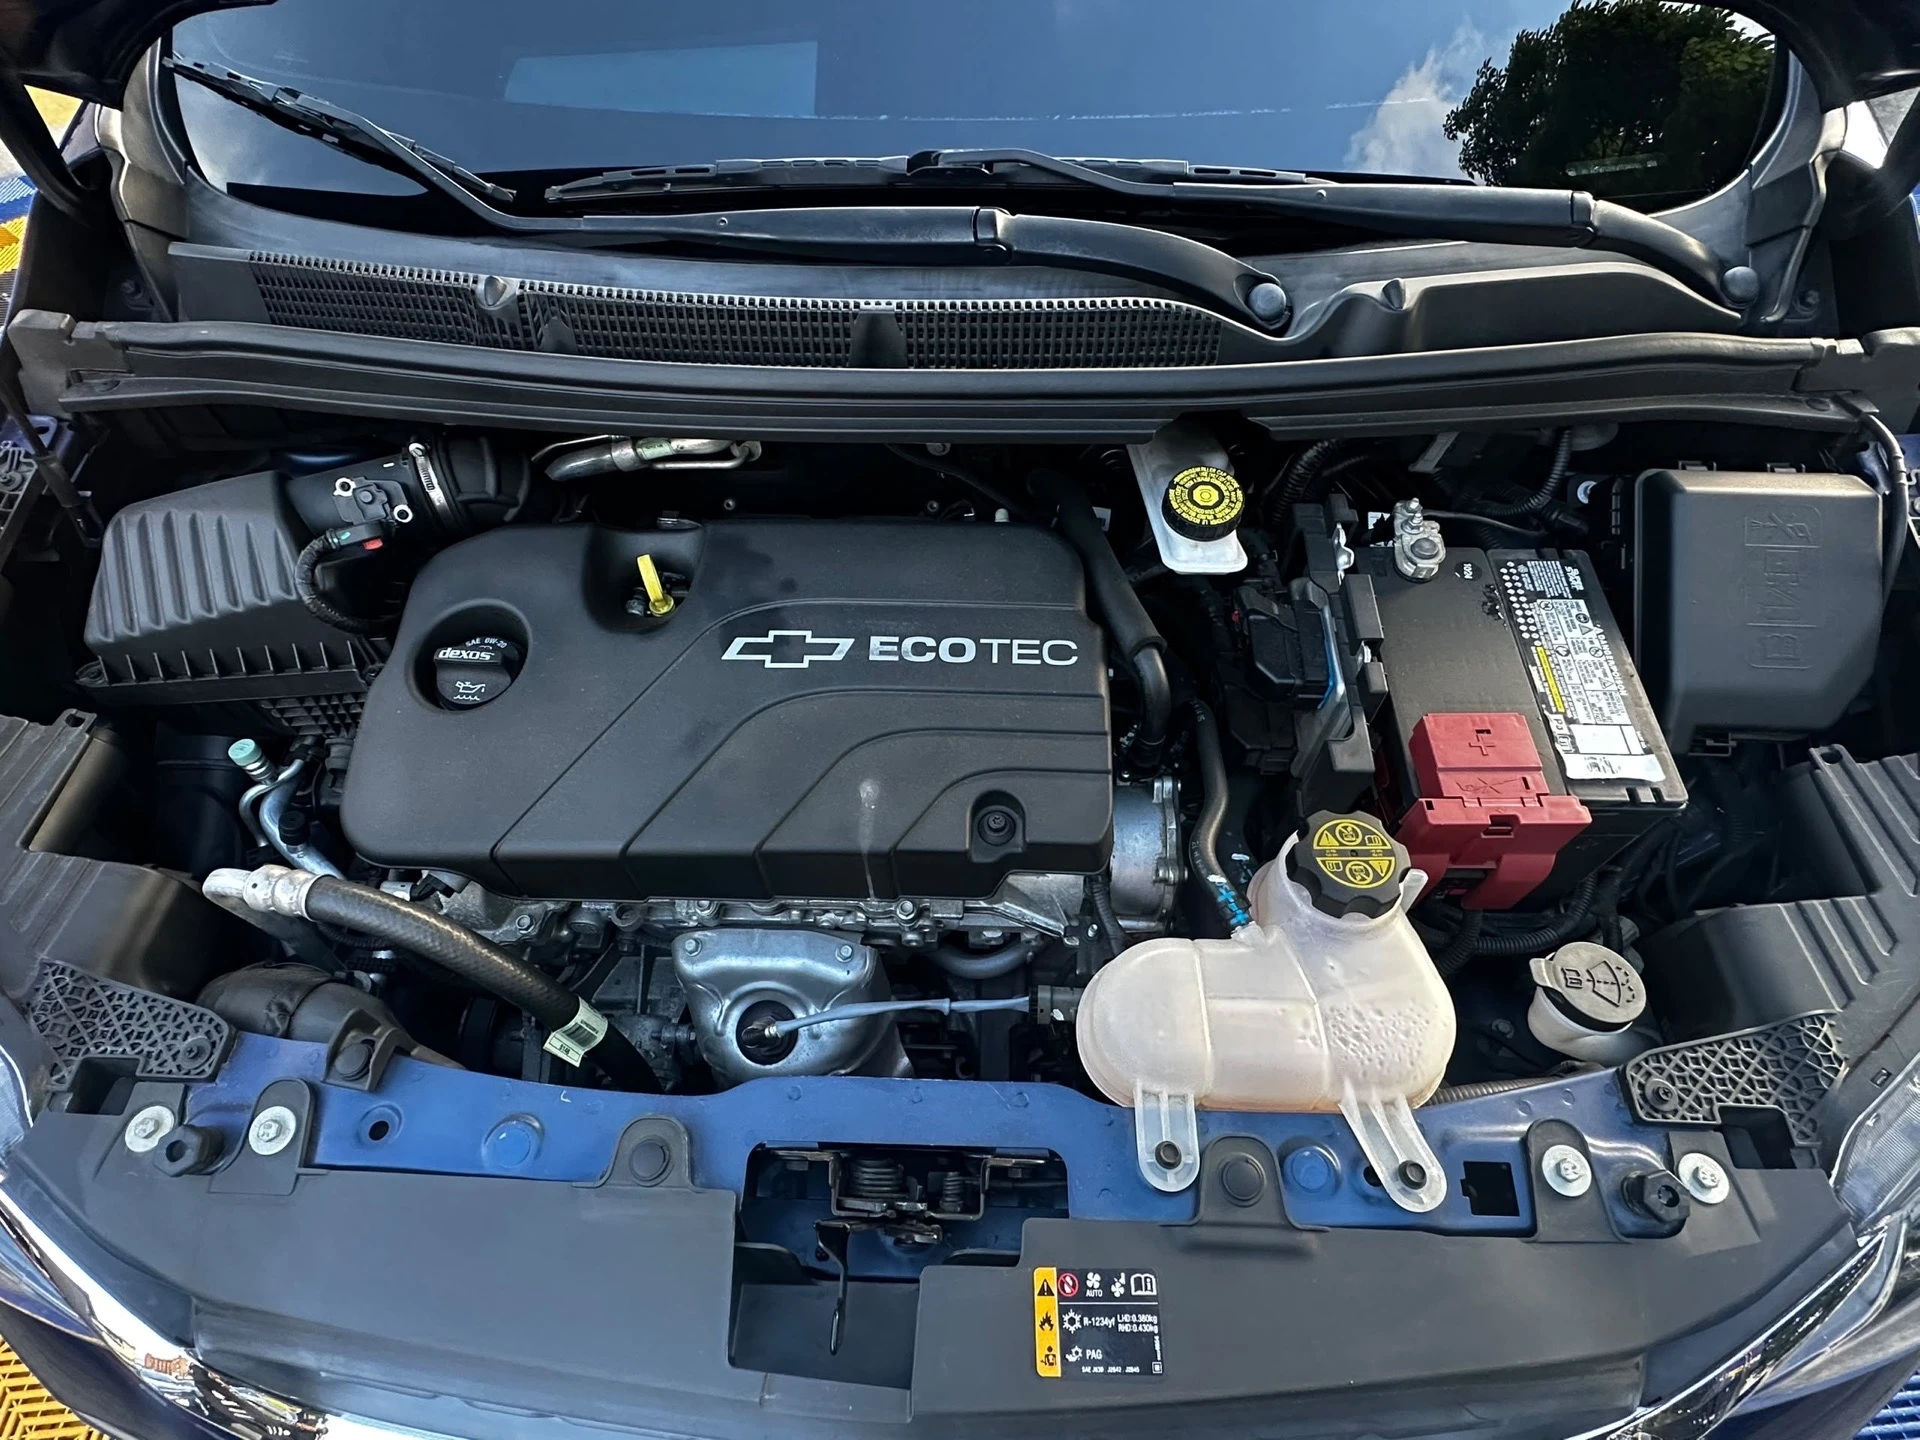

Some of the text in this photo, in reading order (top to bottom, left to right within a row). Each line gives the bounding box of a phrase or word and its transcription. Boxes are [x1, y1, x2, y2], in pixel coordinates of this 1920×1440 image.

[465, 637, 508, 649] SAE 0W-20
[438, 647, 495, 660] dexos
[868, 636, 1079, 666] ECOTEC
[1083, 1316, 1116, 1328] R-1234yf
[1086, 1349, 1103, 1360] PAG
